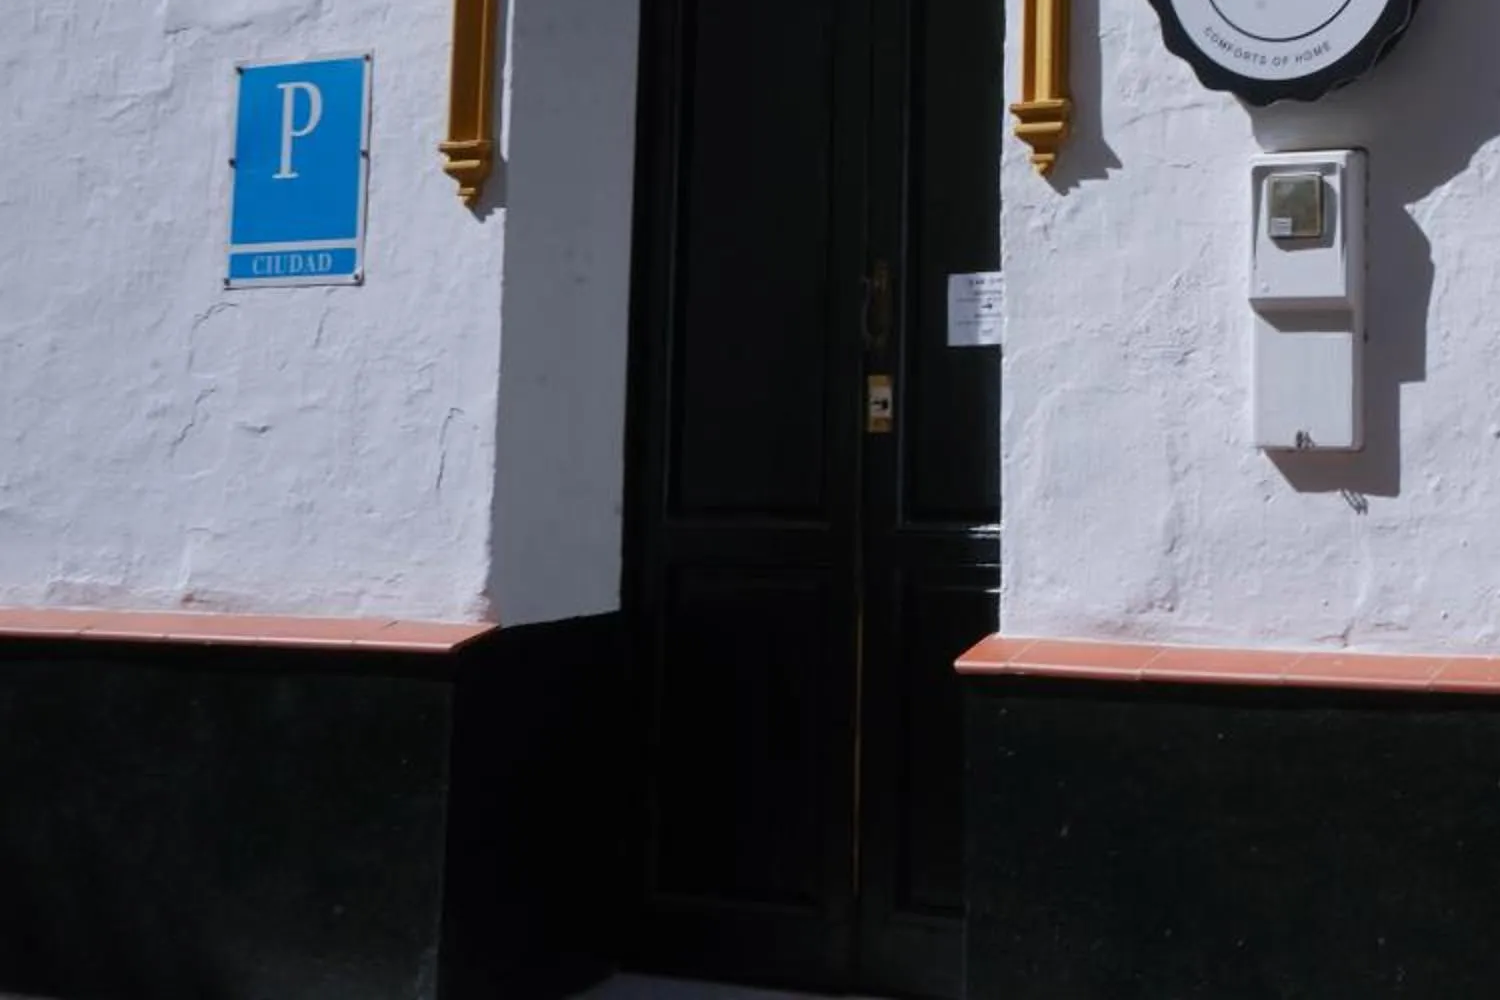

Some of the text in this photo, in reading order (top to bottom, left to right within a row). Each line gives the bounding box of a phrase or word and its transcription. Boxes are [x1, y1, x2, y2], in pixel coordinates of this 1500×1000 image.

[1203, 26, 1331, 67] COMFORTS OF HOME
[271, 81, 323, 180] P
[252, 252, 333, 275] CIUDAD
